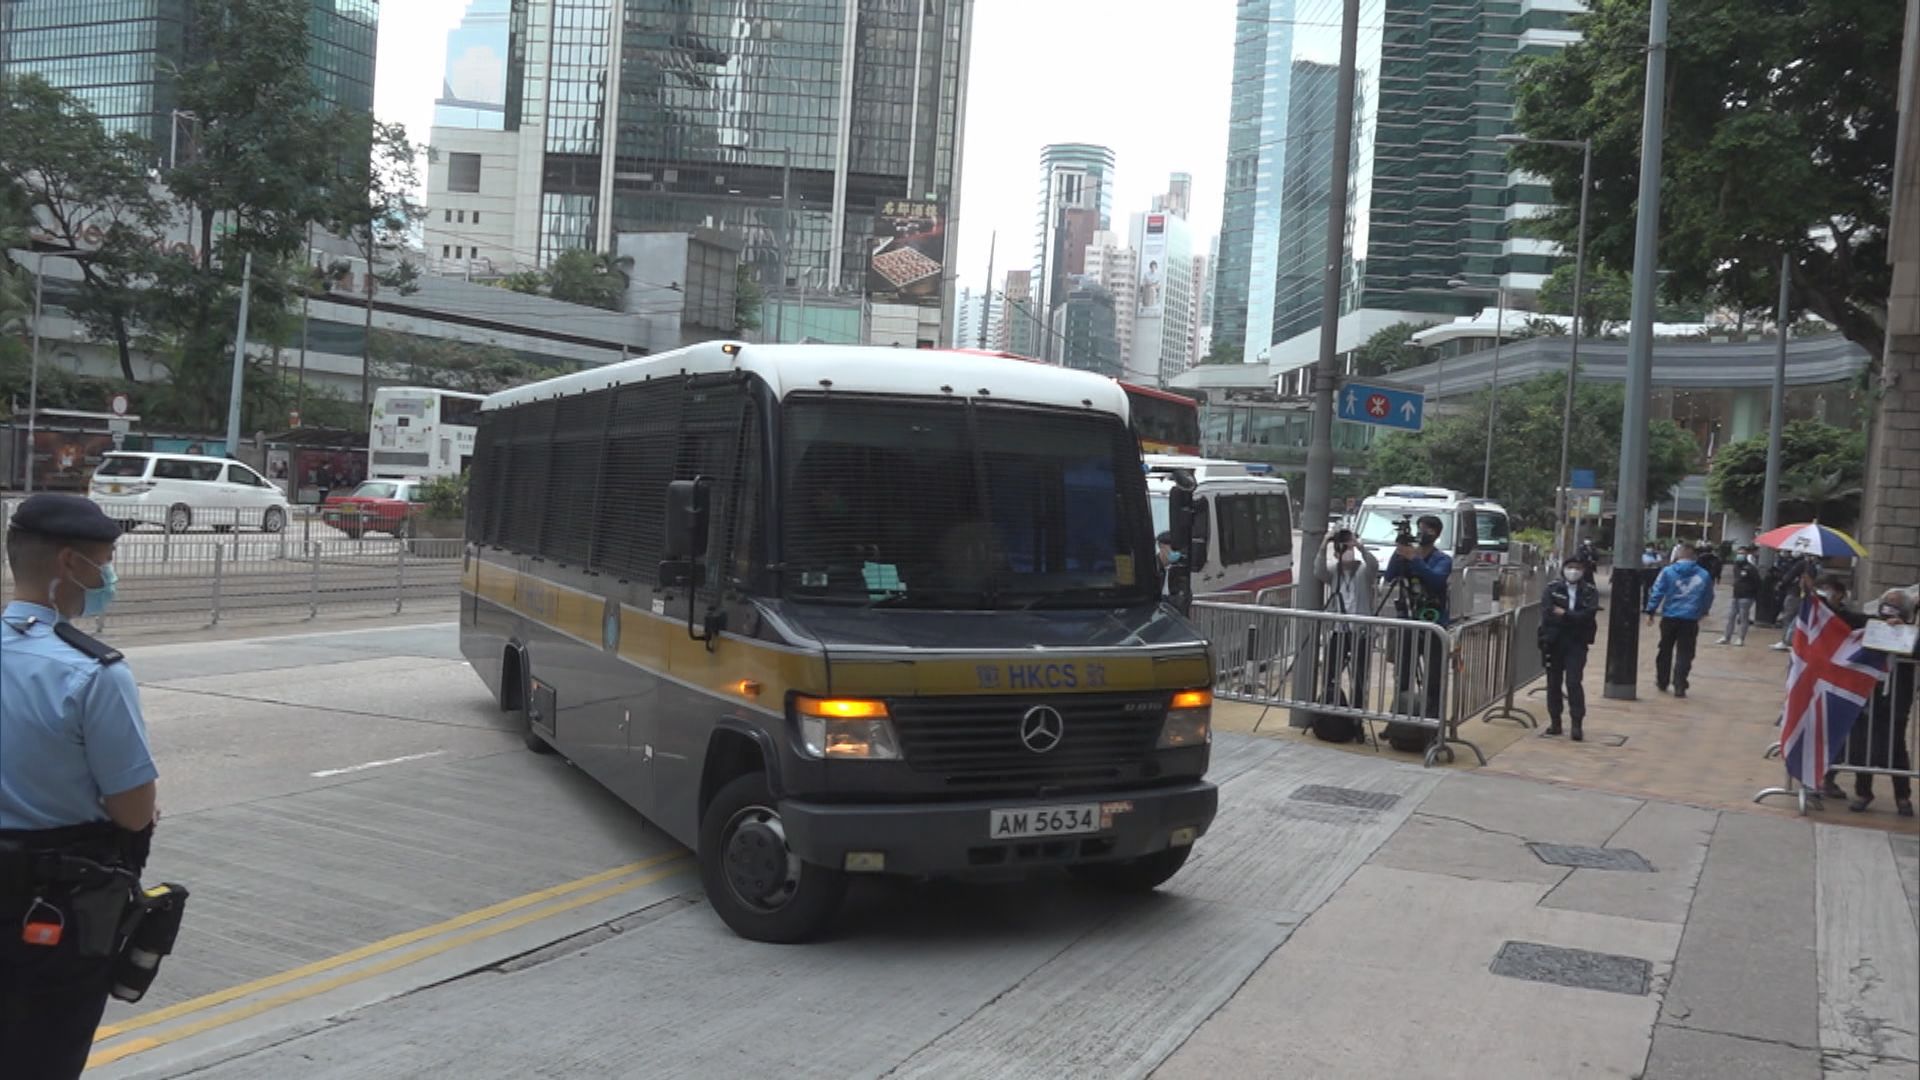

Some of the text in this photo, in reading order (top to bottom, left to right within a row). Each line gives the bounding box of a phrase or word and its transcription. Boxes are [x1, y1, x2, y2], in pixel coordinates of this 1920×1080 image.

[1008, 664, 1078, 688] HKCS
[998, 809, 1093, 834] AM 5634
